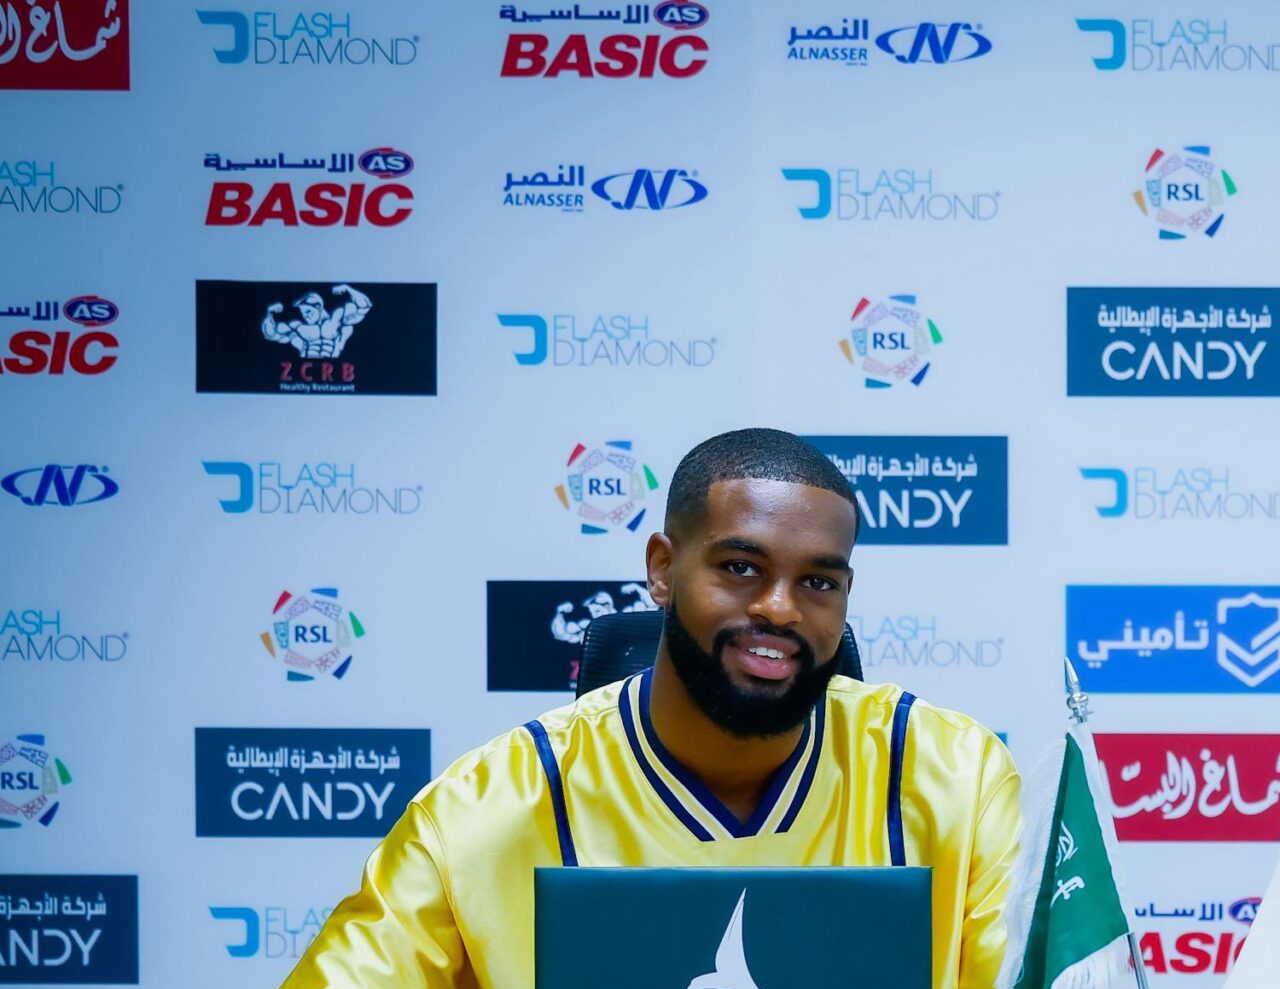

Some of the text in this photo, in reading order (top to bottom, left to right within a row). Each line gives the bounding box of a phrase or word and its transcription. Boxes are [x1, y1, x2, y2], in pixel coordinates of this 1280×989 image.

[253, 11, 350, 39] FLASH
[787, 18, 869, 46] النصر
[1131, 19, 1227, 46] FLASH
[253, 37, 418, 65] DIAMOND
[499, 32, 709, 79] BASIC
[787, 47, 869, 62] ALNASSER
[0, 161, 55, 187] ASH
[503, 164, 585, 192] النصر
[837, 168, 933, 195] FLASH
[0, 185, 122, 214] AMOND
[204, 181, 414, 228] BASIC
[502, 192, 584, 207] ALNASSER
[1166, 183, 1204, 202] RSL
[837, 193, 999, 221] DIAMOND
[554, 314, 649, 342] FLASH
[1225, 305, 1272, 334] شركة
[0, 330, 119, 376] SIC
[554, 339, 714, 367] DIAMOND
[872, 331, 910, 350] RSL
[1101, 340, 1267, 381] CANDY
[258, 461, 354, 489] FLASH
[931, 453, 978, 483] شركة
[1133, 468, 1229, 493] FLASH
[258, 486, 421, 515] DIAMOND
[588, 477, 626, 496] RSL
[856, 488, 974, 530] ANDY
[0, 609, 60, 636] ASH
[294, 624, 332, 644] RSL
[1, 634, 127, 662] AMOND
[863, 638, 1003, 668] IAMOND
[1077, 610, 1210, 669] تأميني
[350, 746, 401, 775] شركة
[230, 781, 396, 821] CANDY
[61, 896, 107, 921] شركة
